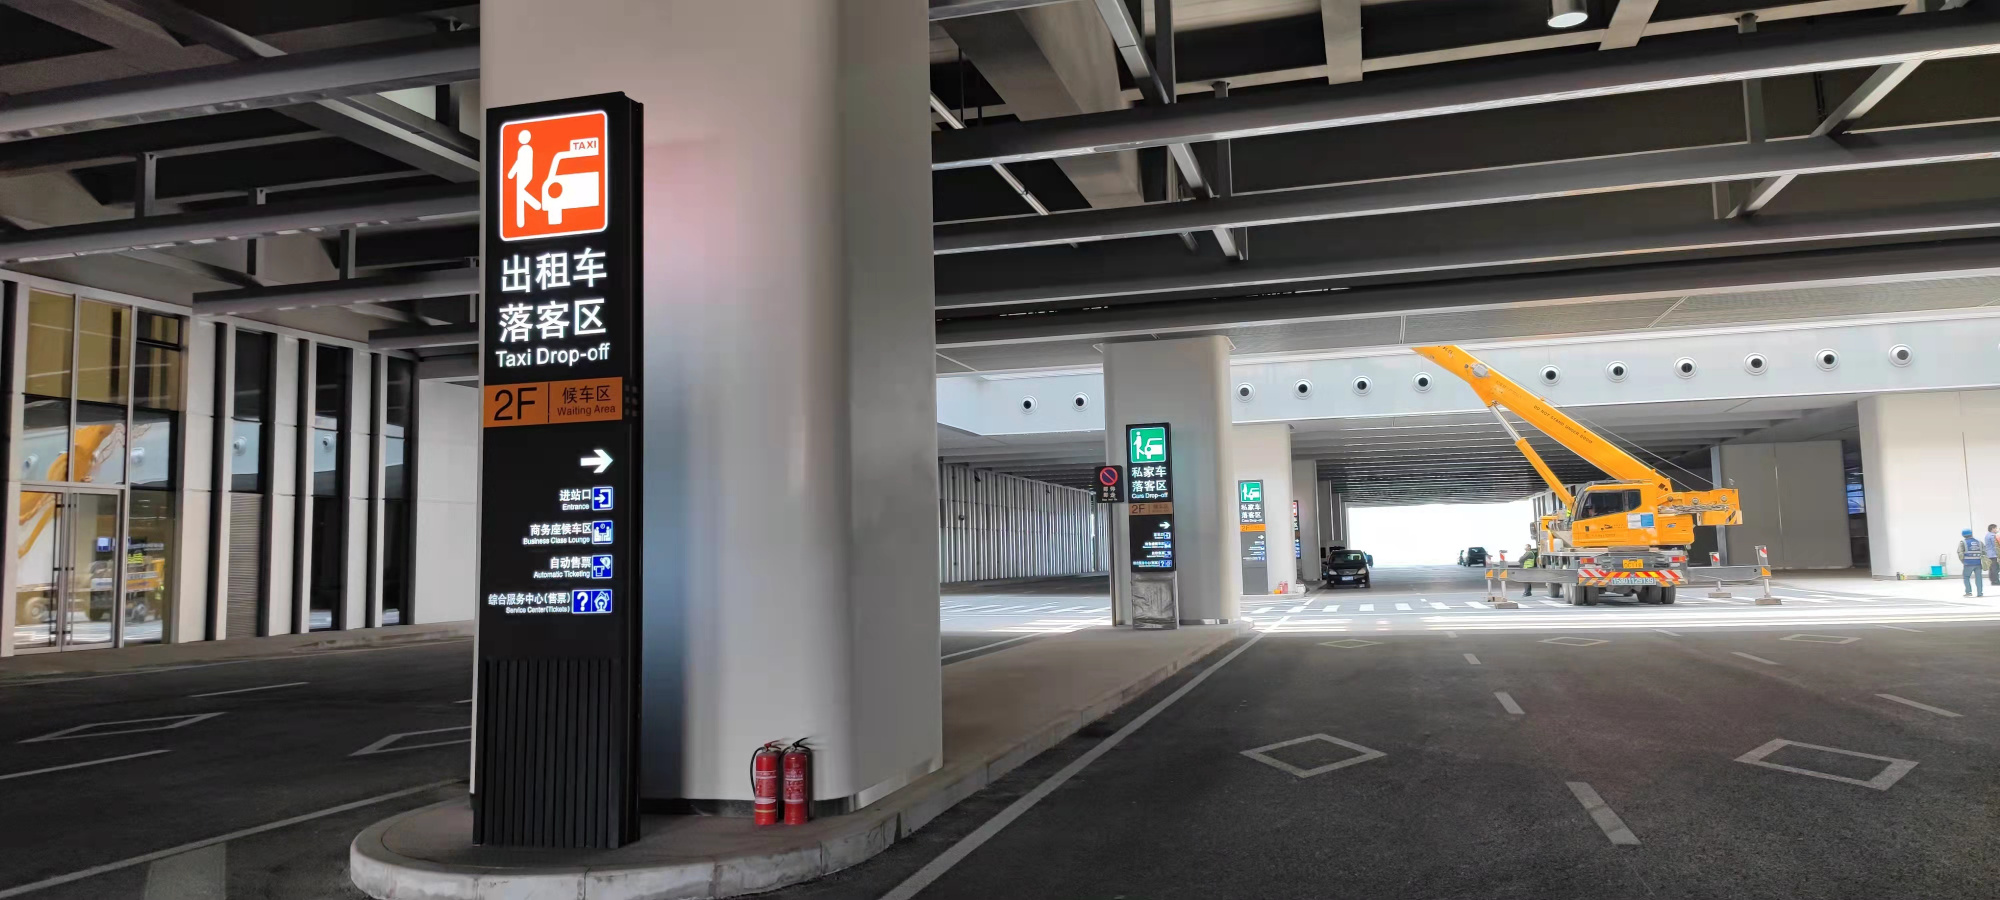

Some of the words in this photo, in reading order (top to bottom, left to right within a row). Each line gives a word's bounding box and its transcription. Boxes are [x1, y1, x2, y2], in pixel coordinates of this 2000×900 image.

[573, 140, 596, 150] TAXI
[501, 247, 607, 293] 出租车
[499, 298, 607, 343] 落客区
[495, 348, 531, 367] Taxi
[536, 342, 610, 367] Drop-off
[562, 384, 612, 405] 候车区
[494, 386, 538, 421] 2F
[557, 406, 592, 417] Waiting
[594, 404, 616, 414] Area
[1131, 465, 1167, 478] 私家车
[1131, 479, 1167, 492] 落客区
[559, 489, 591, 501] 进站口
[562, 503, 590, 511] Entrance
[1131, 503, 1146, 514] 2F
[530, 523, 592, 536] 商务座候车区
[522, 537, 550, 545] Business
[550, 536, 568, 544] Class
[568, 536, 591, 544] Lounge
[550, 556, 592, 570] 自动售票
[533, 571, 563, 579] Automatic
[563, 570, 591, 579] Ticketing
[505, 606, 527, 614] Service
